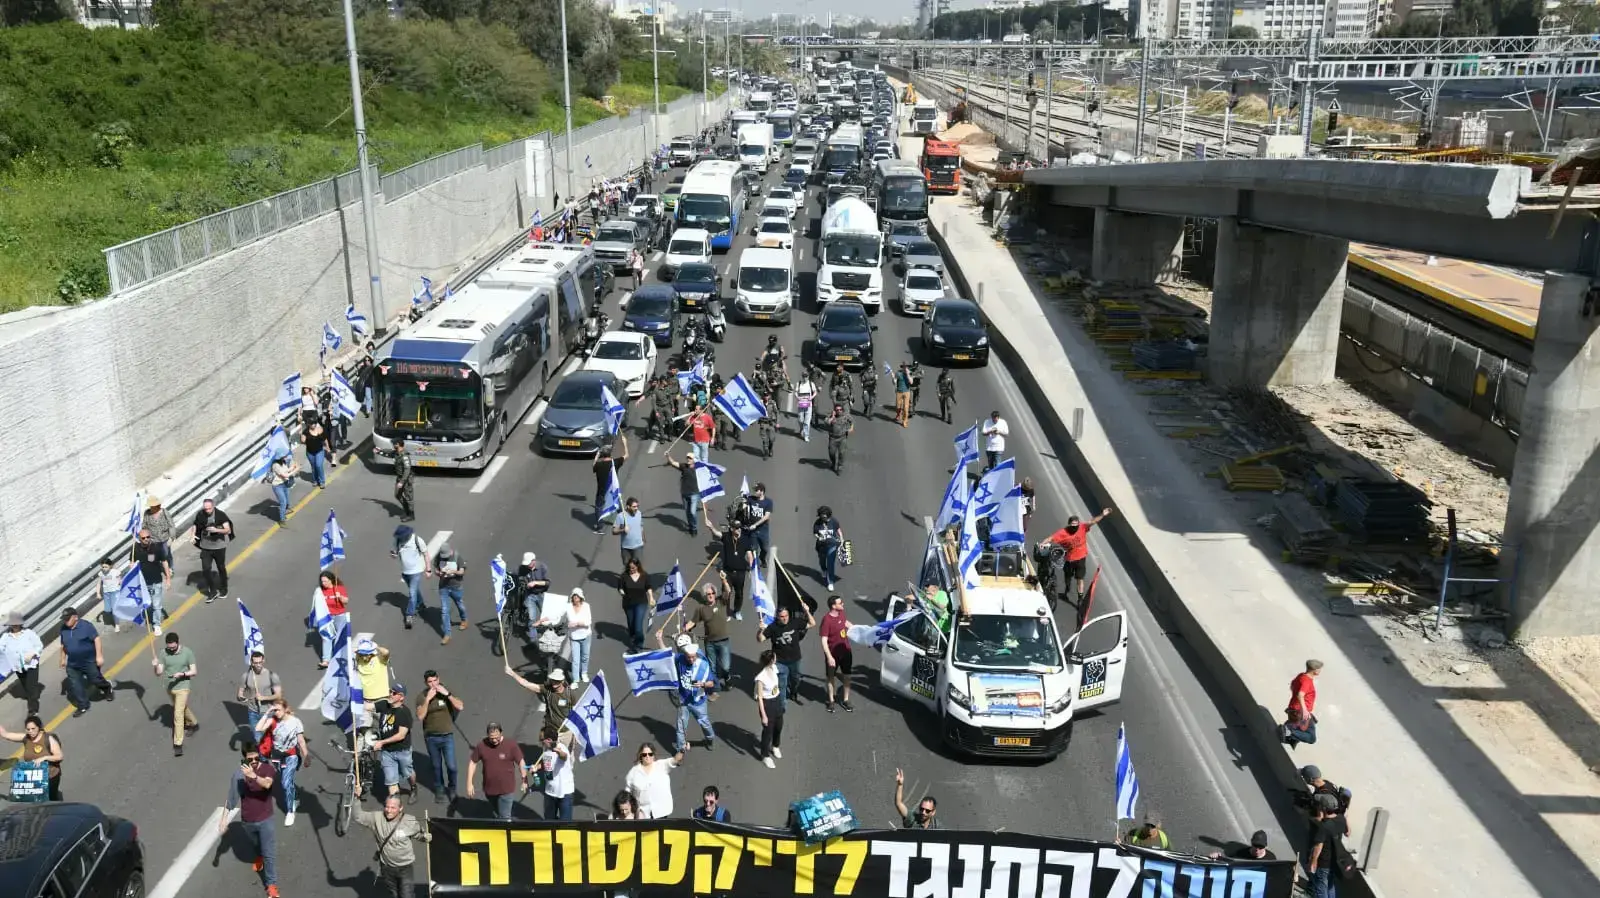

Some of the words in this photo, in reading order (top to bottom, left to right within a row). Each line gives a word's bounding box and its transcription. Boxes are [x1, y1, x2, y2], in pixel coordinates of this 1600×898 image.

[912, 676, 935, 693] חובה
[1079, 687, 1104, 699] להתנגד
[1080, 681, 1105, 693] חובה
[458, 828, 869, 896] לדיקטטורה
[871, 840, 1141, 898] להתנגד
